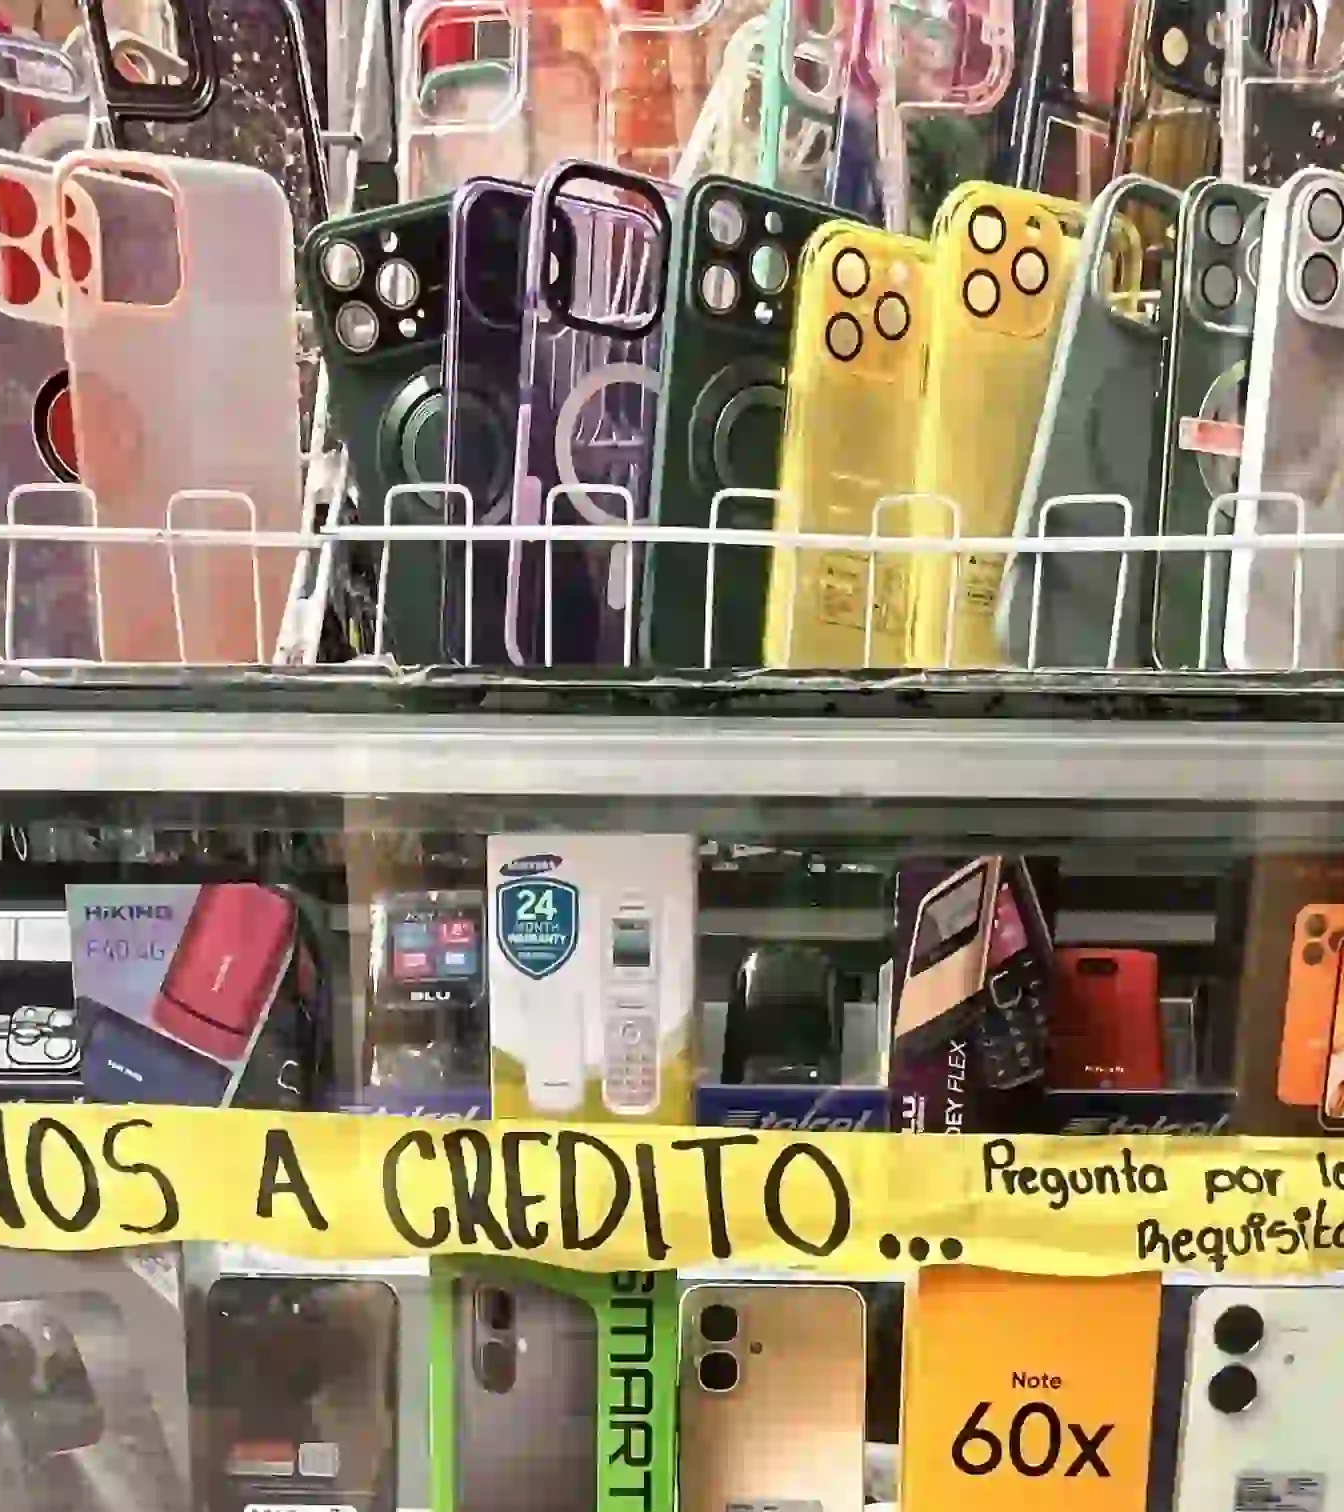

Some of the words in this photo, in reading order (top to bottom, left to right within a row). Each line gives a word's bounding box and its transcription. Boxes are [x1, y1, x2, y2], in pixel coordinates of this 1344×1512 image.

[515, 888, 558, 922] 24
[947, 1039, 968, 1093] FLEX
[256, 1129, 329, 1231] A
[982, 1138, 1168, 1210] Pregunta
[1205, 1163, 1284, 1203] por
[1011, 1371, 1063, 1391] Note
[950, 1400, 1117, 1479] 60x
